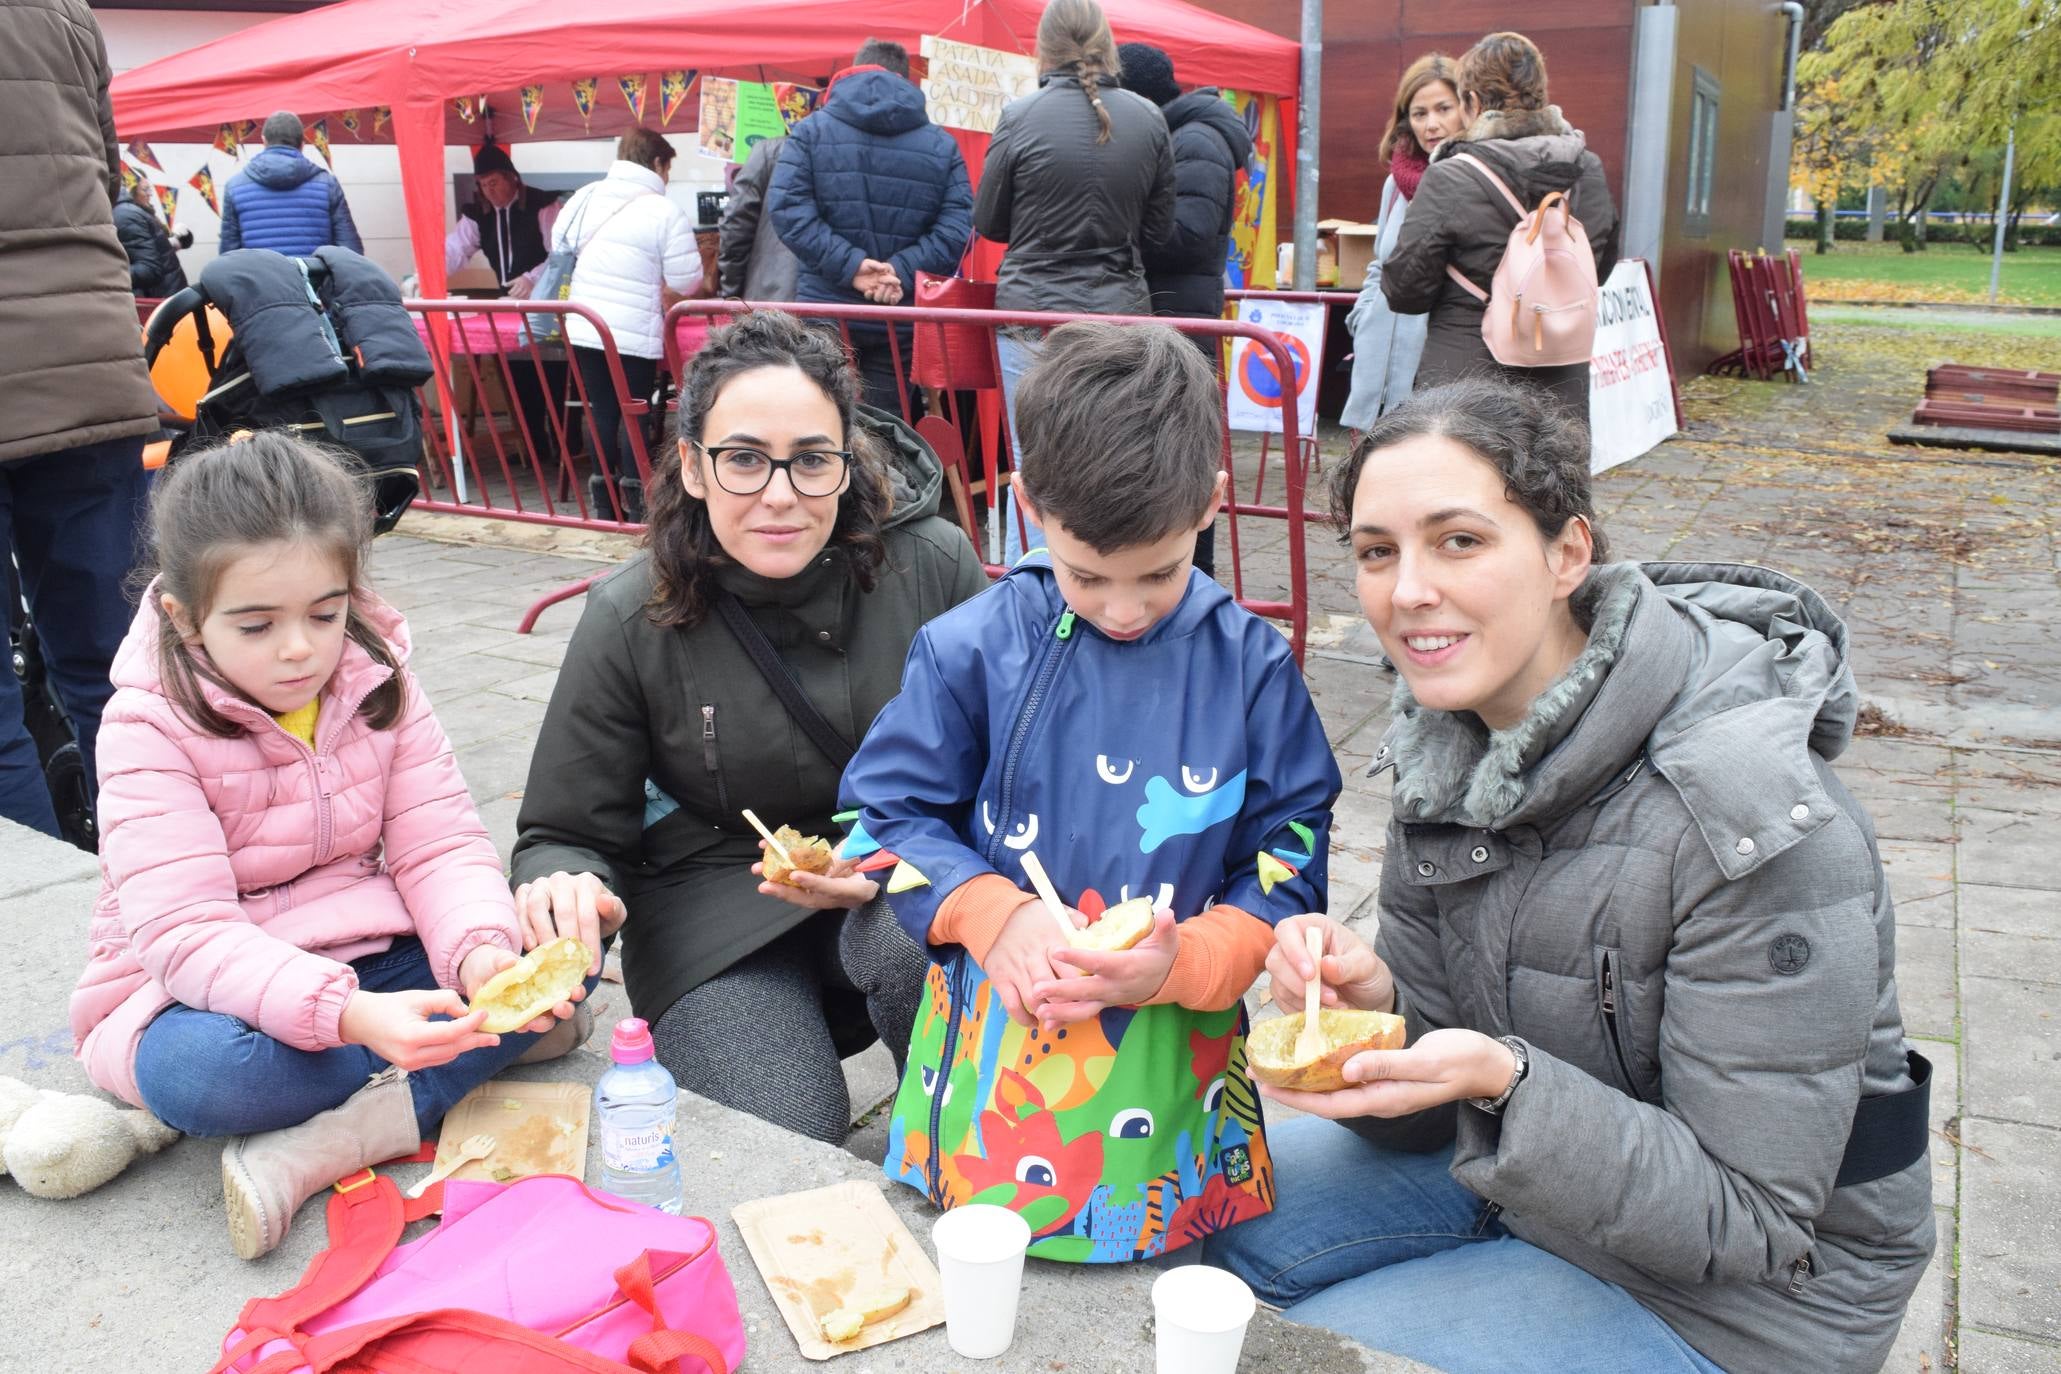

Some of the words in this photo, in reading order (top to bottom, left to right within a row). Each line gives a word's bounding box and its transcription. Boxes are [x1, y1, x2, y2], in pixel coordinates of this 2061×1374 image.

[933, 40, 1004, 69] PATATA
[937, 63, 1001, 88] ASADA
[1010, 76, 1027, 97] Y
[957, 107, 997, 132] VIN
[624, 1131, 660, 1146] naturis
